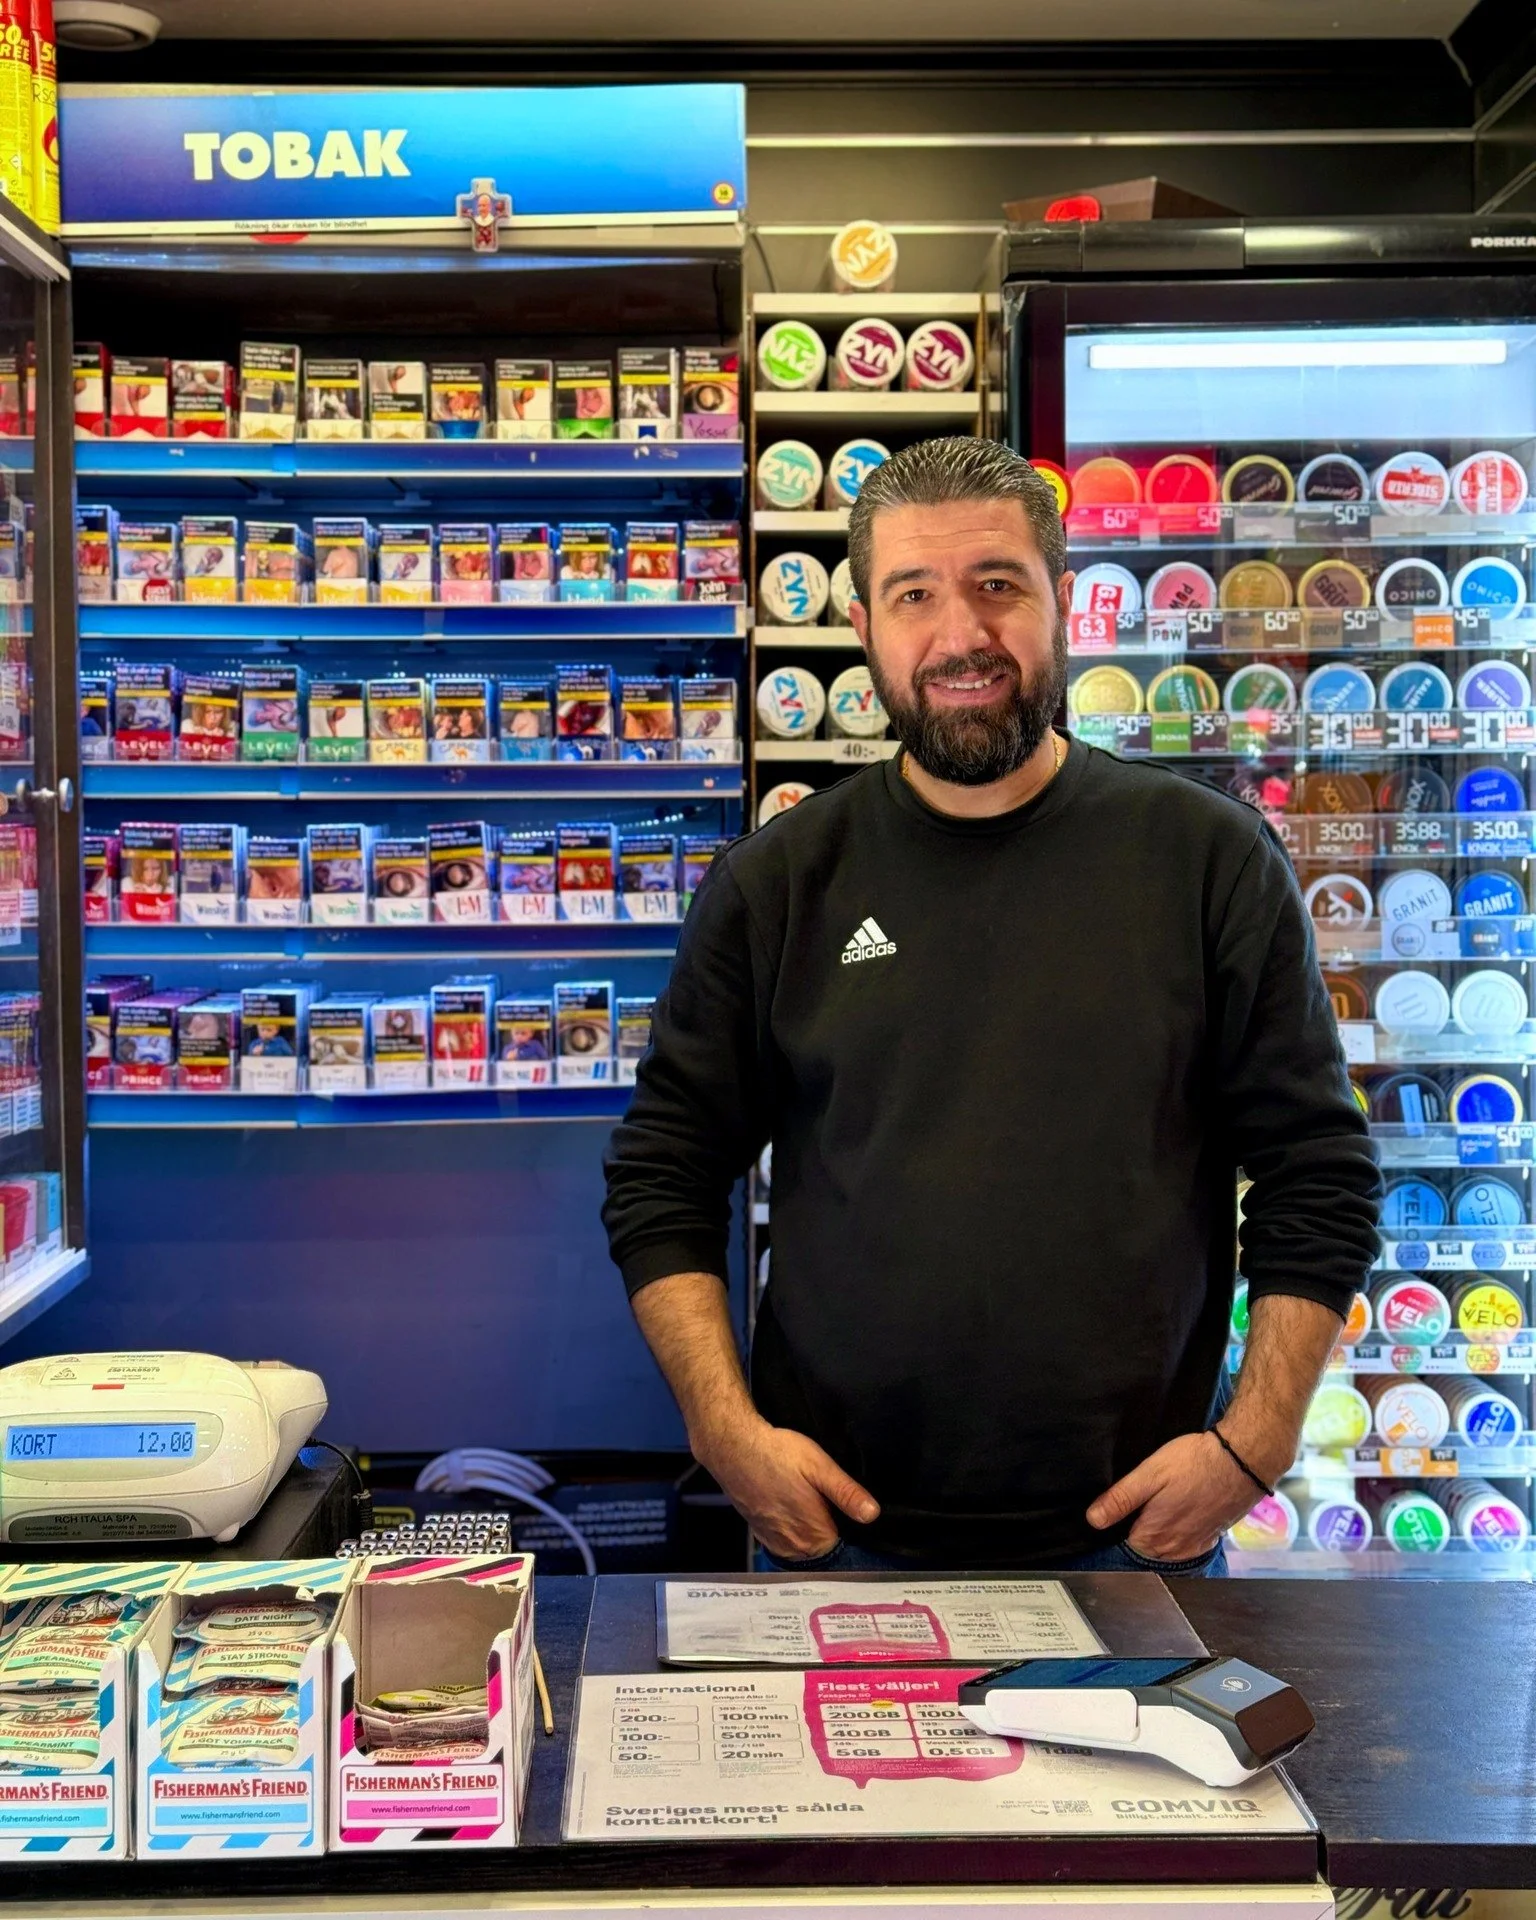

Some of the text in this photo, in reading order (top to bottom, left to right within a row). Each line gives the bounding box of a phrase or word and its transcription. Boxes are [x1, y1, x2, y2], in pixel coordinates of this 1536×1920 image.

[183, 129, 412, 181] TOBAK
[334, 219, 368, 229] blindhet
[1470, 236, 1536, 248] PORKKA
[845, 229, 889, 274] ZYN
[774, 334, 817, 376] ZYN
[845, 332, 896, 369] ZYN
[918, 332, 963, 375] ZYN
[760, 458, 813, 489] ZYN
[836, 456, 880, 483] ZY
[780, 559, 808, 616] ZYN
[1467, 582, 1512, 606] ONICO
[1389, 590, 1437, 602] ONICO
[1078, 618, 1106, 637] G.3
[1416, 625, 1452, 634] ONICO
[773, 673, 807, 730] ZYN
[121, 740, 165, 754] LEVEL
[184, 741, 229, 756] LEVEL
[248, 741, 292, 756] LEVEL
[314, 744, 358, 758] LEVEL
[842, 743, 876, 758] 40:-
[1319, 822, 1364, 841] 35.00
[1473, 821, 1519, 840] 35.00
[1393, 888, 1439, 922] GRANIT
[1464, 891, 1515, 917] GRANIT
[841, 942, 897, 964] adidas
[121, 1074, 164, 1086] PRINCE
[185, 1073, 223, 1084] PRINCE
[1404, 1186, 1422, 1241] VELO
[1390, 1298, 1443, 1335] VELO
[1462, 1306, 1520, 1329] VELO
[1476, 1402, 1505, 1447] VELO
[11, 1431, 194, 1455] KORT 12,00
[55, 1513, 138, 1524] RCH ITALIA SPA
[1479, 1508, 1515, 1551] VELO
[234, 1613, 294, 1623] DATE NIGHT
[11, 1645, 107, 1660] FISHERMAN'S FRIE
[220, 1652, 289, 1662] STAY STRONG
[32, 1656, 93, 1666] SPEARMINT
[615, 1683, 757, 1695] International
[817, 1681, 941, 1693] Flest väljer!
[620, 1714, 676, 1723] 200:-
[719, 1713, 789, 1722] 100 min
[917, 1710, 956, 1719] 100
[0, 1728, 64, 1739] SHERMAN'S
[183, 1724, 299, 1739] FISHERMAN'S FRIEND
[618, 1733, 671, 1742] 100:-
[721, 1732, 782, 1740] 50 min
[13, 1740, 75, 1748] SPEARMINT
[618, 1752, 662, 1762] 50:-
[721, 1751, 751, 1759] 20
[154, 1777, 308, 1800] FISHERMAN'S FRIEND
[346, 1772, 498, 1793] FISHERMAN'S FRIEND
[0, 1781, 108, 1801] RMAN'S FRIEND
[180, 1808, 281, 1820] www.fishermansfriend.com
[371, 1803, 471, 1814] www.fishermansfriend.com
[606, 1802, 865, 1817] Sveriges mest sålda
[1110, 1799, 1263, 1814] COMVIQ
[0, 1813, 80, 1824] .fishermansfriend.com
[605, 1813, 778, 1826] kontantkort!
